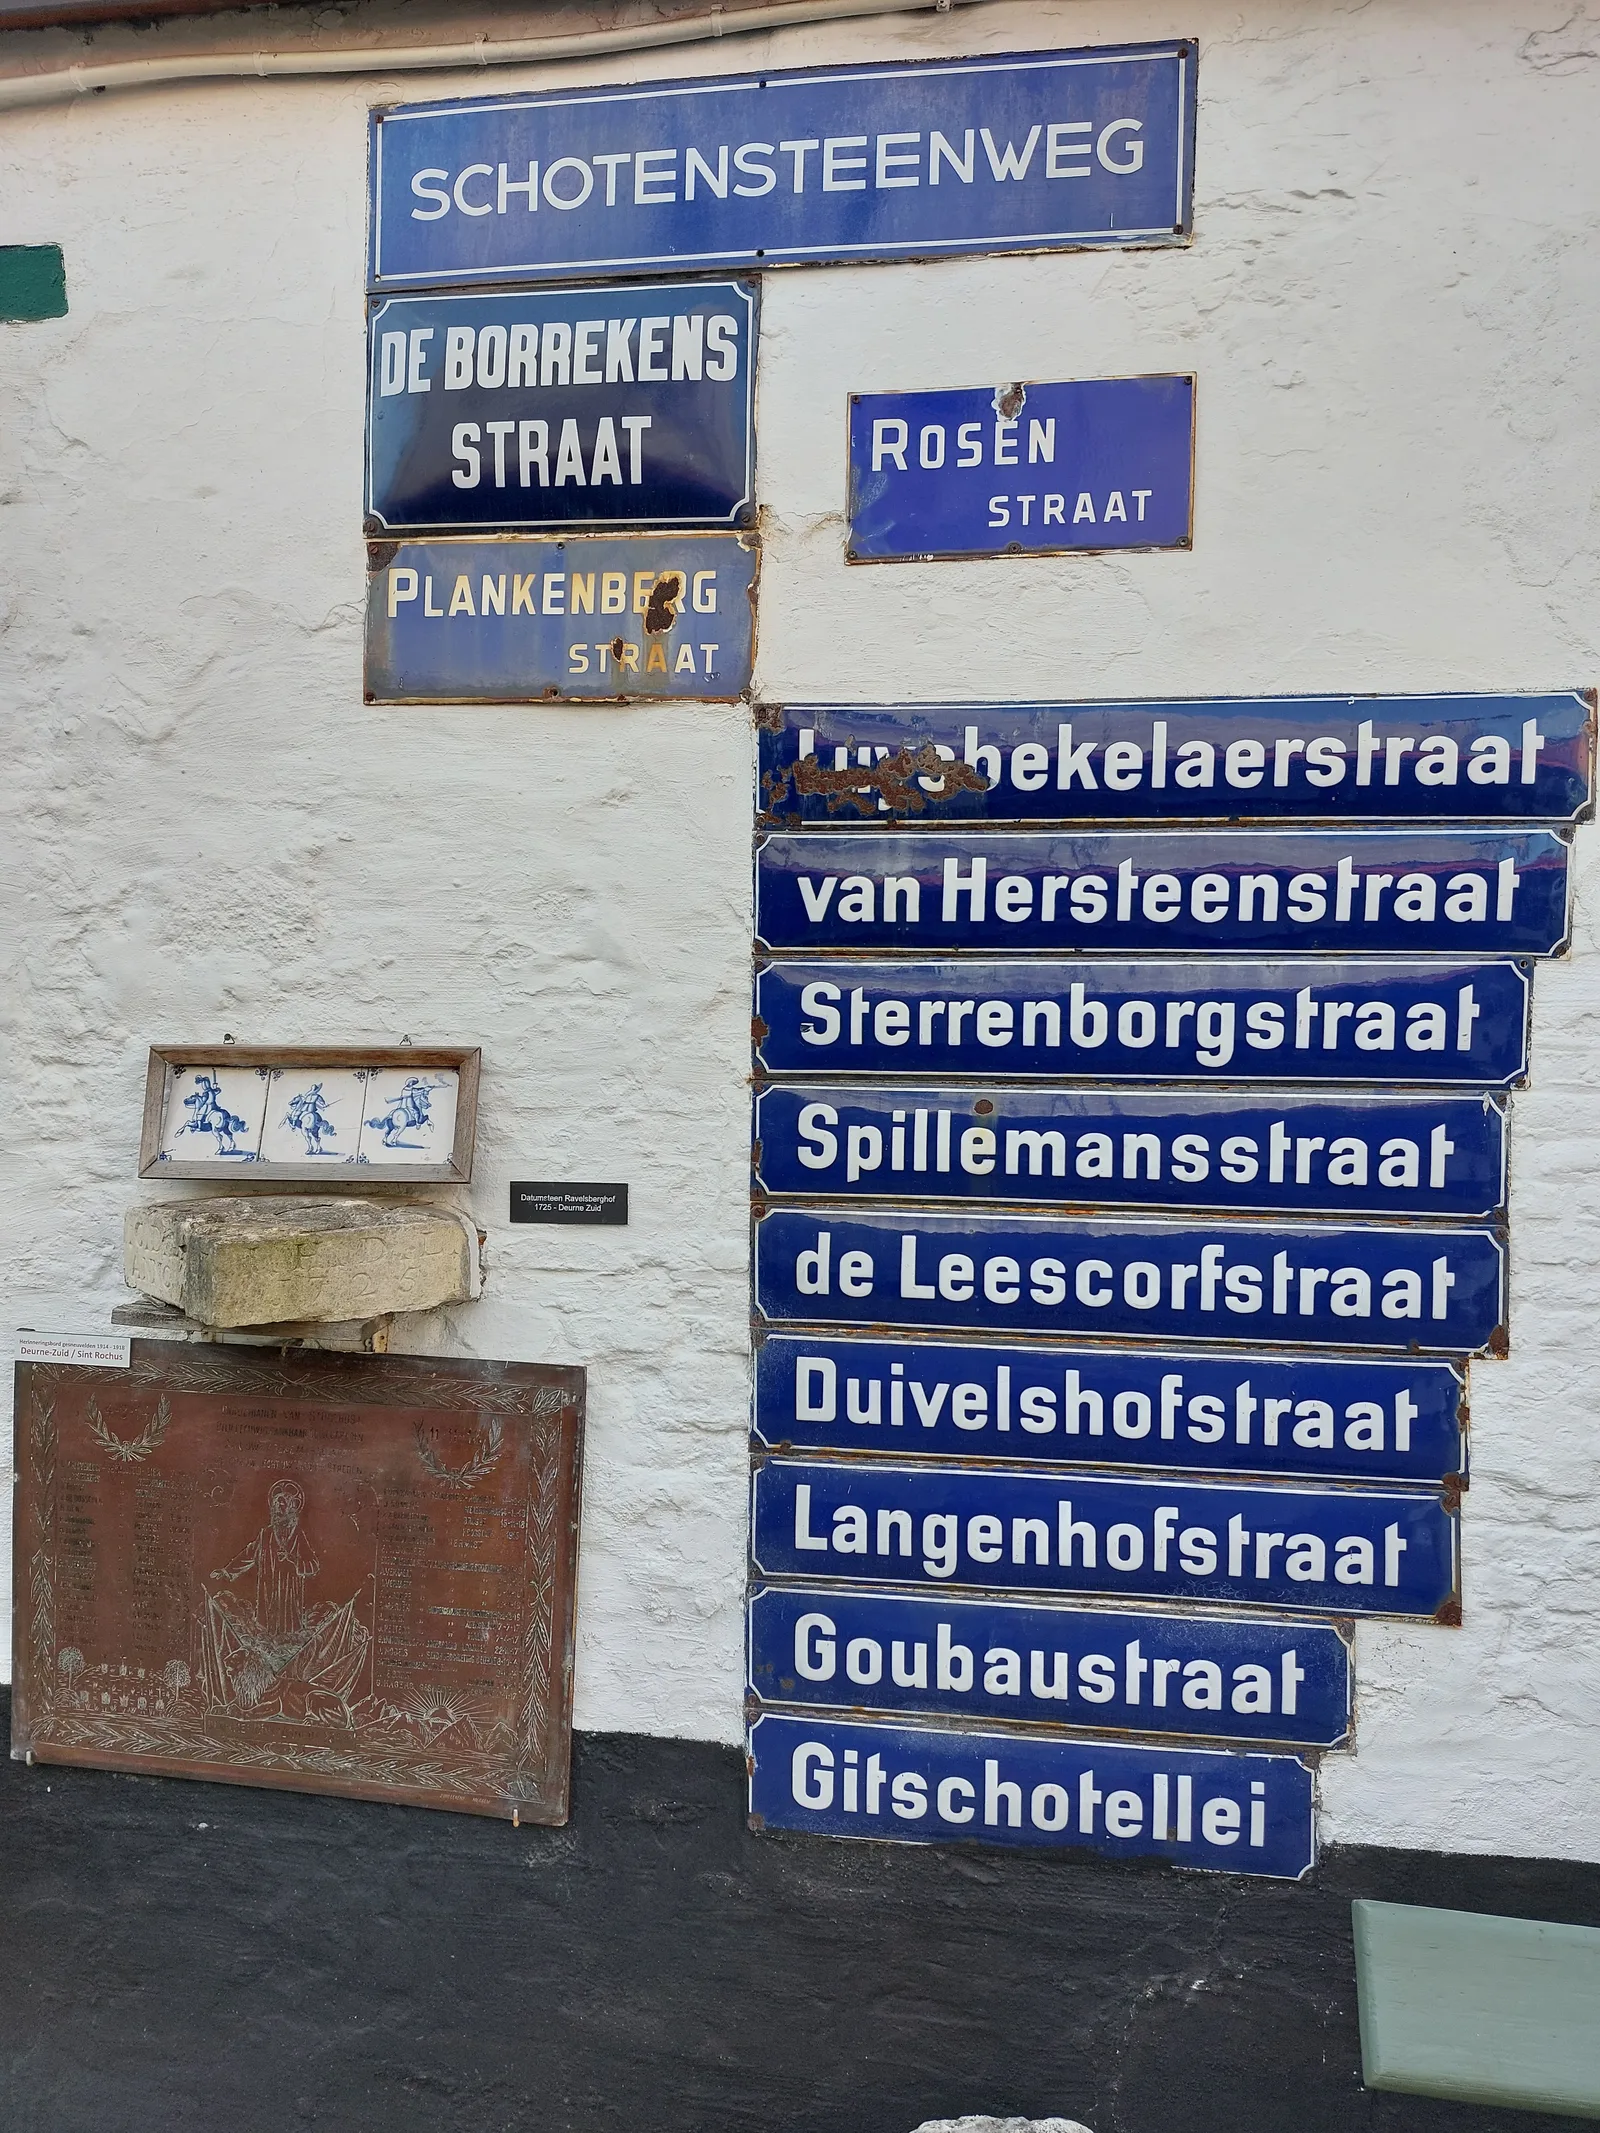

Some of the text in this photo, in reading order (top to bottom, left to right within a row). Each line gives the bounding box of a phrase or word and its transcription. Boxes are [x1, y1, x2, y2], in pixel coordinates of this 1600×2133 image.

[410, 117, 1145, 221] SCHOTENSTEENWEG
[380, 314, 739, 398] DE BORREKENS
[451, 415, 652, 489] STRAAT
[871, 417, 1057, 472] ROSEN
[988, 489, 1154, 528] STRAAT
[568, 642, 720, 674] STRAAT
[797, 855, 1520, 924] van Hersteenstraat
[800, 981, 1481, 1069] Sterrenborgstraat
[797, 1103, 1455, 1189] Spillemansstraat
[520, 1194, 616, 1204] Datumsteen Ravelsberghof
[558, 1204, 585, 1212] Deurne
[585, 1204, 602, 1212] Zuid
[796, 1231, 1457, 1322] de Leescorfstraat
[19, 1339, 62, 1347] Herinneringsbord
[62, 1341, 96, 1349] gesneuvelden
[20, 1346, 69, 1357] Deurne-Zuid
[77, 1350, 93, 1359] Sint
[94, 1351, 123, 1361] Rochus
[795, 1356, 1419, 1452] Duivelshofstraat
[795, 1484, 1408, 1587] Langenhofstraat
[794, 1612, 1305, 1715] Goubaustraat
[791, 1742, 1266, 1848] Gitschotellei
